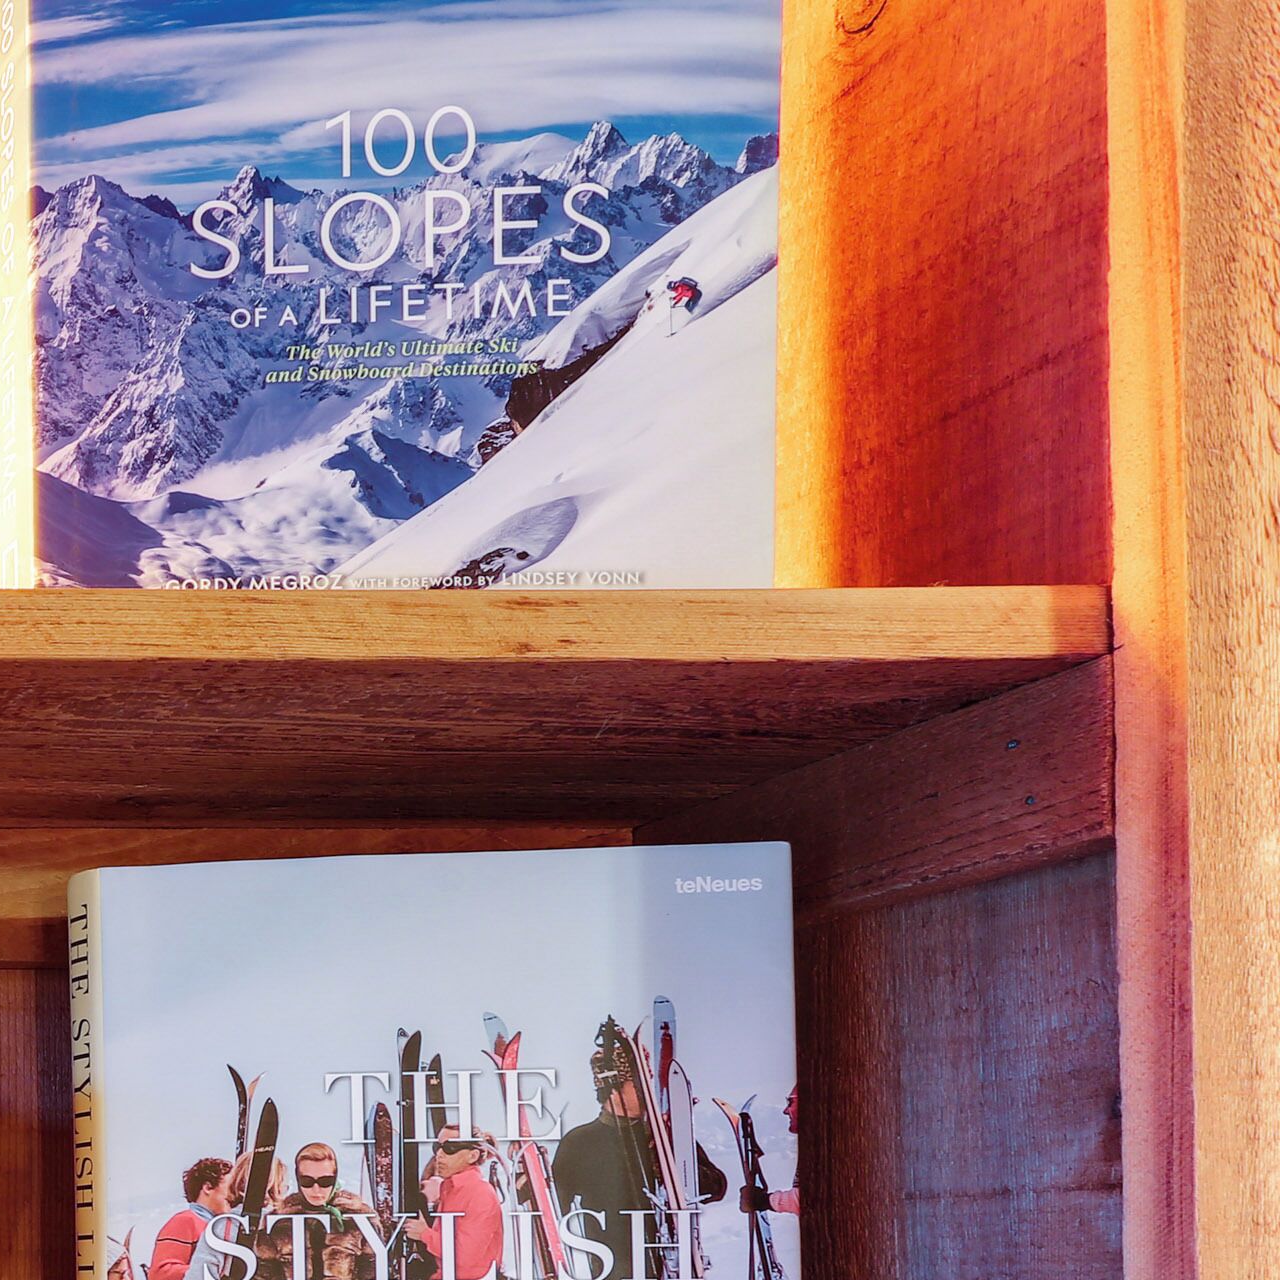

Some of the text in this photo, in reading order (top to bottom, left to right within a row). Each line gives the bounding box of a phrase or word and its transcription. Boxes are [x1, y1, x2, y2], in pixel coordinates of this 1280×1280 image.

[325, 105, 476, 177] 100
[190, 183, 611, 279] SLOPES
[230, 279, 573, 329] OF A LIFETIME
[265, 360, 538, 384] and Snowboard Destinations
[286, 338, 518, 361] The World's Ultimate Ski
[249, 574, 344, 590] MEGROZ
[349, 578, 387, 588] WITH
[392, 577, 474, 588] FOREWORD
[477, 576, 495, 586] BY
[502, 572, 578, 586] LINDSEY
[585, 571, 641, 585] VONN
[674, 874, 764, 894] teNeues
[69, 903, 90, 1000] THE
[72, 1018, 94, 1211] STYLISH
[323, 1066, 567, 1145] THE
